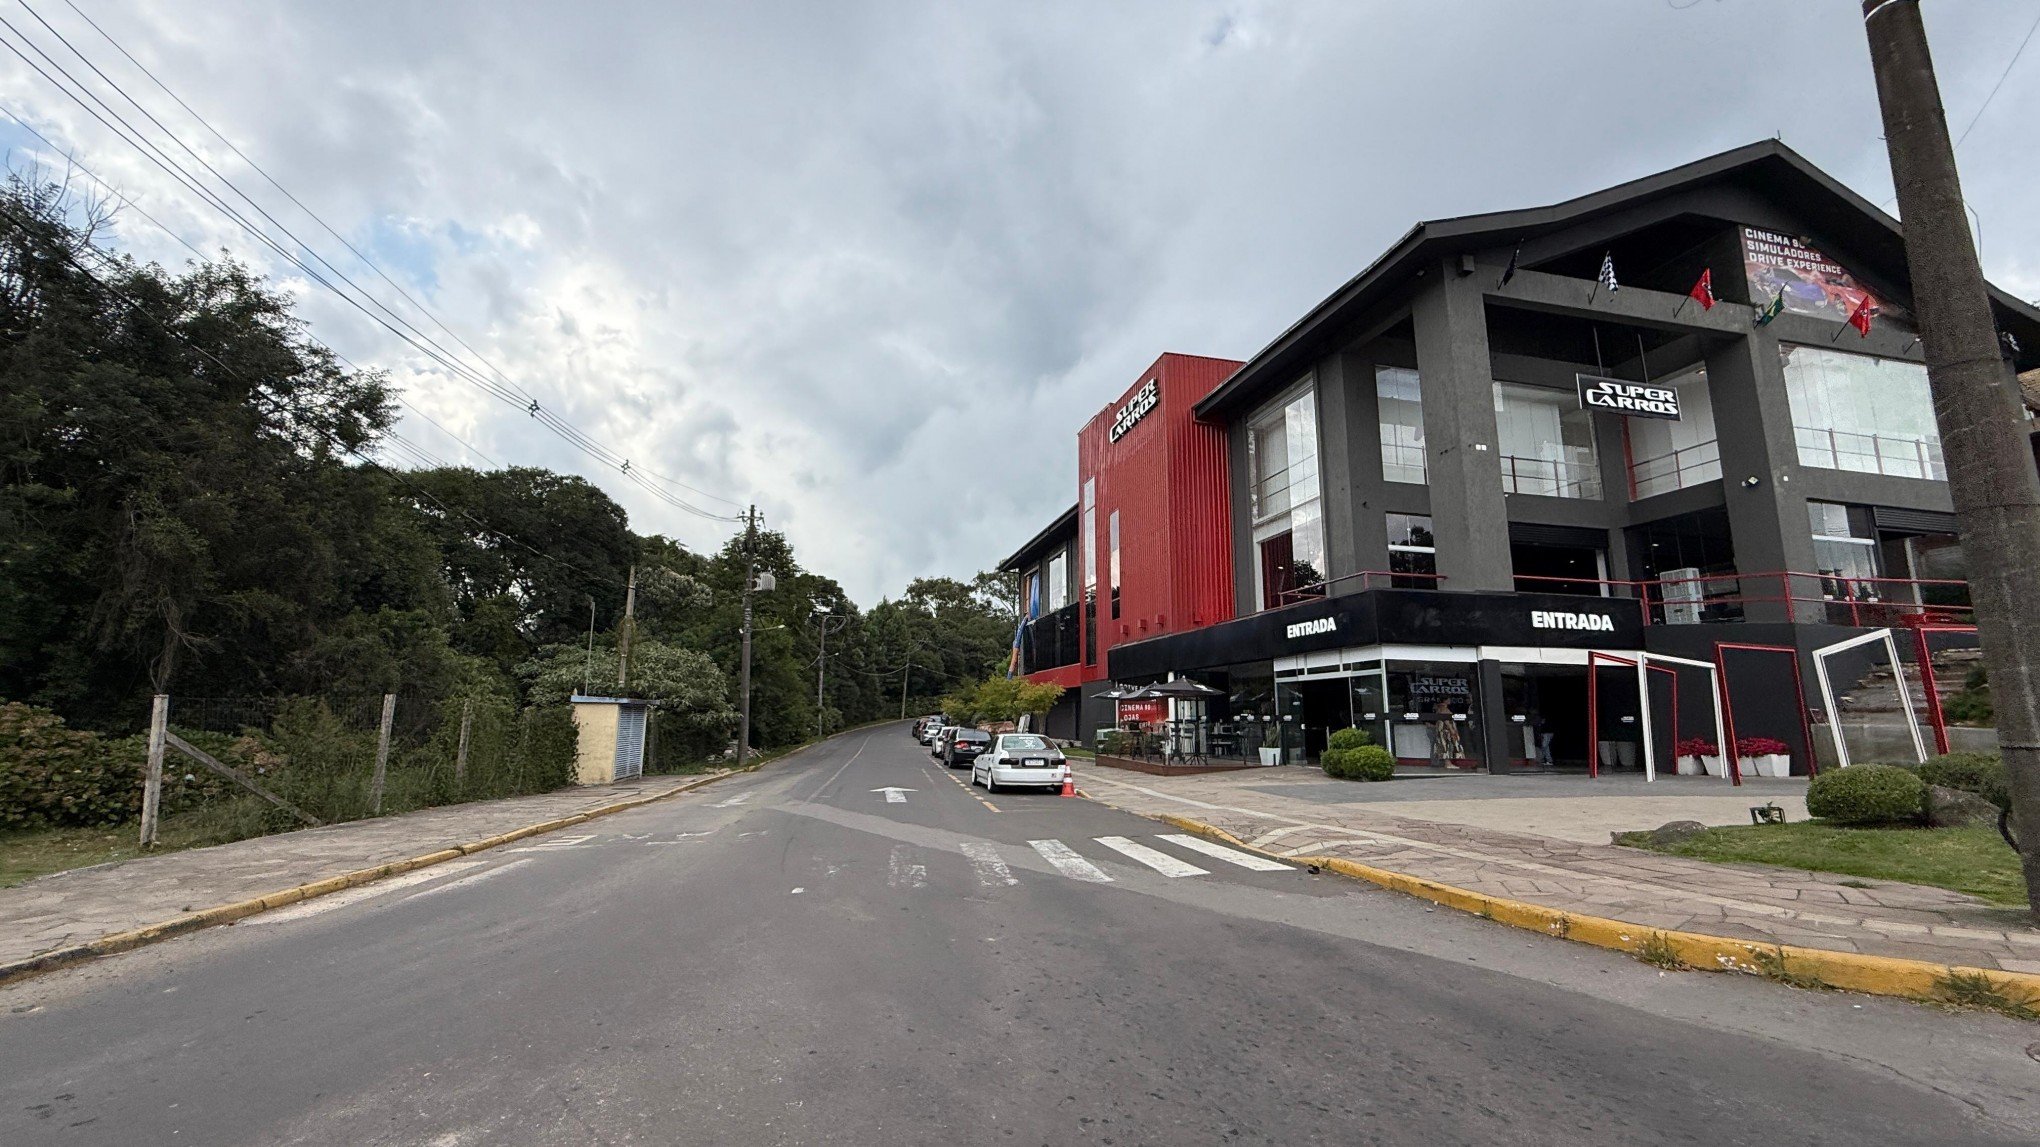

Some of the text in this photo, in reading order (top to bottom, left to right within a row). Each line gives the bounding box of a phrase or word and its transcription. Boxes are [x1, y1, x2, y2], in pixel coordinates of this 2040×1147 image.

[1745, 228, 1805, 249] CINEMA 9
[1747, 240, 1821, 262] SIMULADORES
[1749, 252, 1842, 274] DRIVE EXPERIENCE
[1116, 379, 1156, 420] SUPER
[1586, 389, 1679, 415] CARROS
[1598, 382, 1676, 402] SUPER
[1110, 391, 1157, 443] CARROS
[1286, 617, 1337, 639] ENTRADA
[1531, 611, 1615, 631] ENTRADA
[1419, 677, 1468, 686] SUPER
